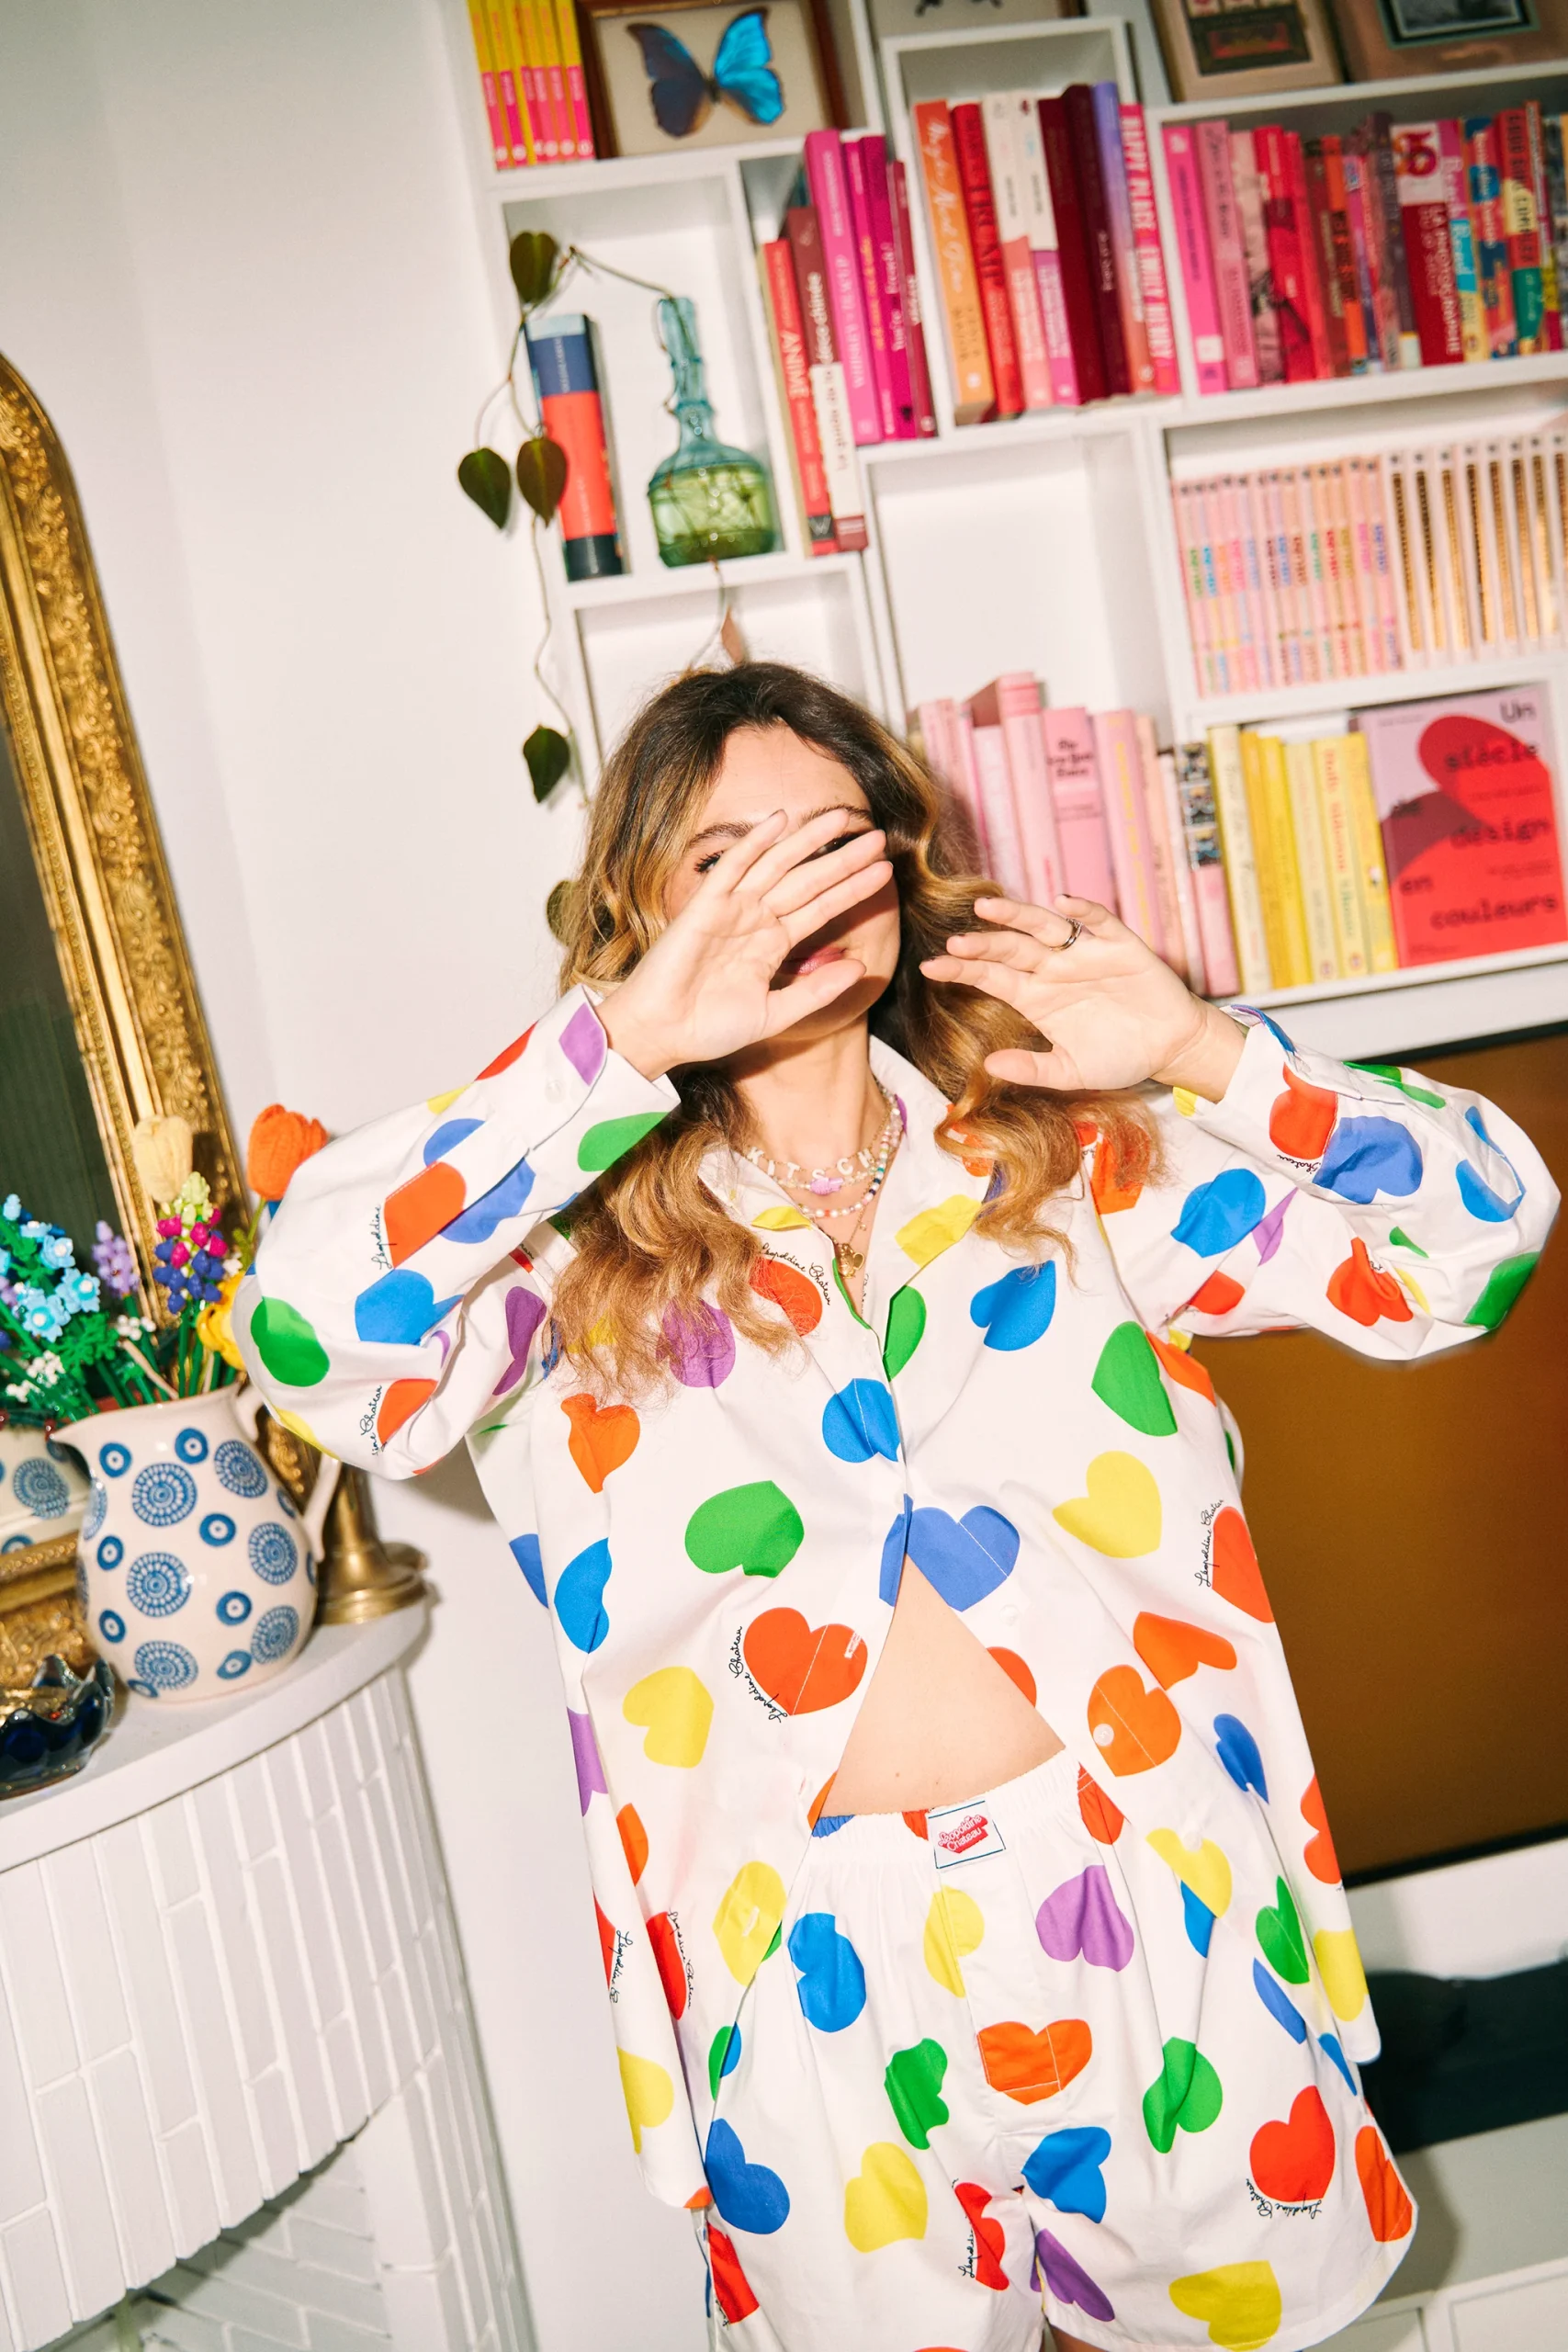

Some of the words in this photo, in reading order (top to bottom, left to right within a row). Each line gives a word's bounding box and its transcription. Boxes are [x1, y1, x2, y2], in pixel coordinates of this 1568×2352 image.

[1122, 117, 1146, 173] HAPPY
[1130, 176, 1156, 232] PLACE
[780, 329, 809, 400] ANIME
[1499, 700, 1537, 723] Un
[1450, 816, 1551, 849] design
[1400, 876, 1434, 896] en
[1430, 894, 1560, 931] couleurs
[728, 1625, 743, 1679] Chateau
[946, 1826, 983, 1852] Chateau
